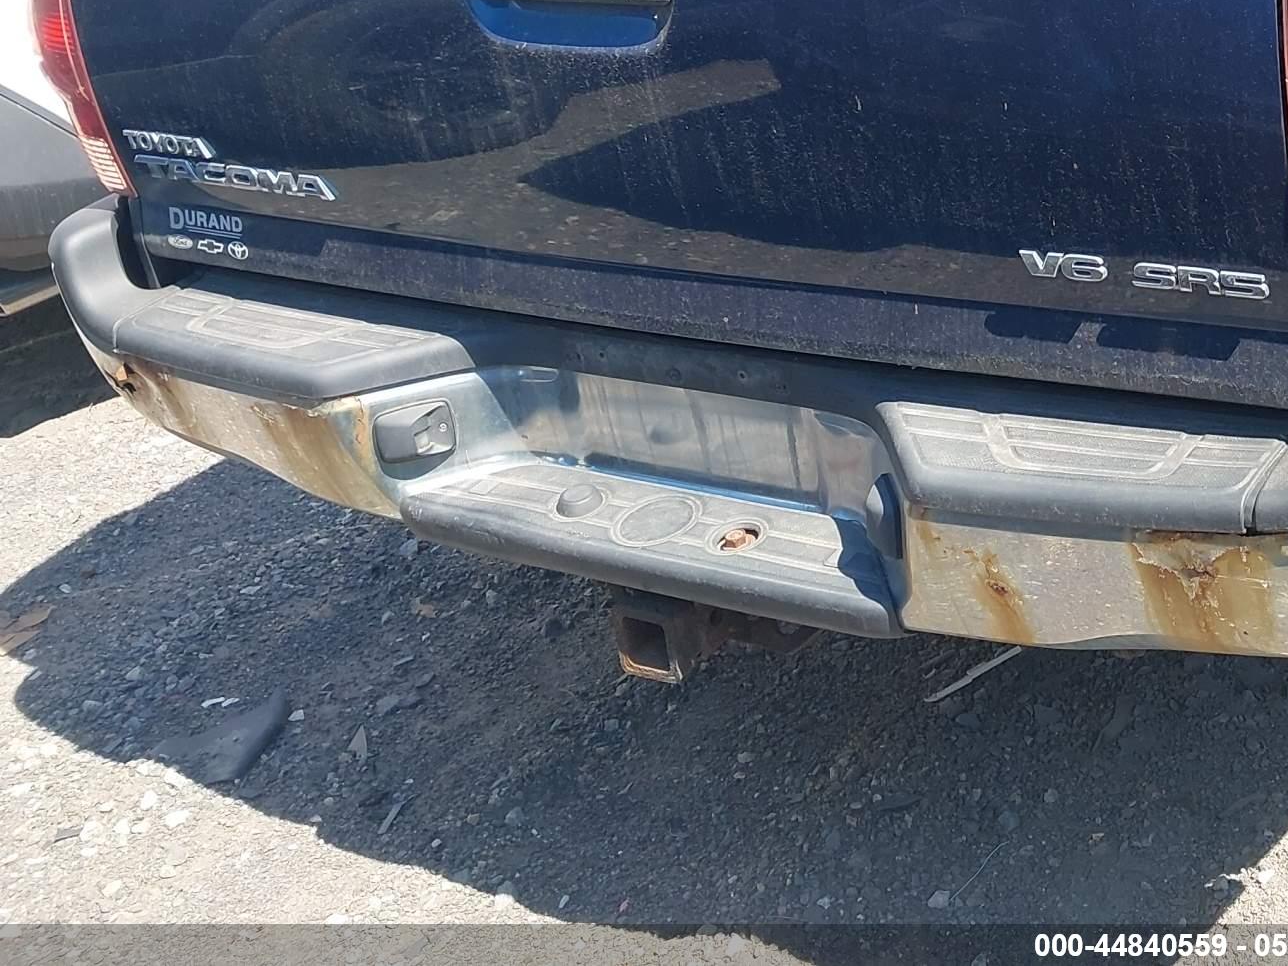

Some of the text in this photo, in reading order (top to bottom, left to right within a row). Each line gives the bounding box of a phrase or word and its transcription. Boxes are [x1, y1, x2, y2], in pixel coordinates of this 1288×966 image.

[122, 129, 216, 159] TOYOTA
[134, 154, 338, 201] TACOMA
[169, 206, 243, 234] DURAND
[1019, 249, 1270, 300] V6 SR5
